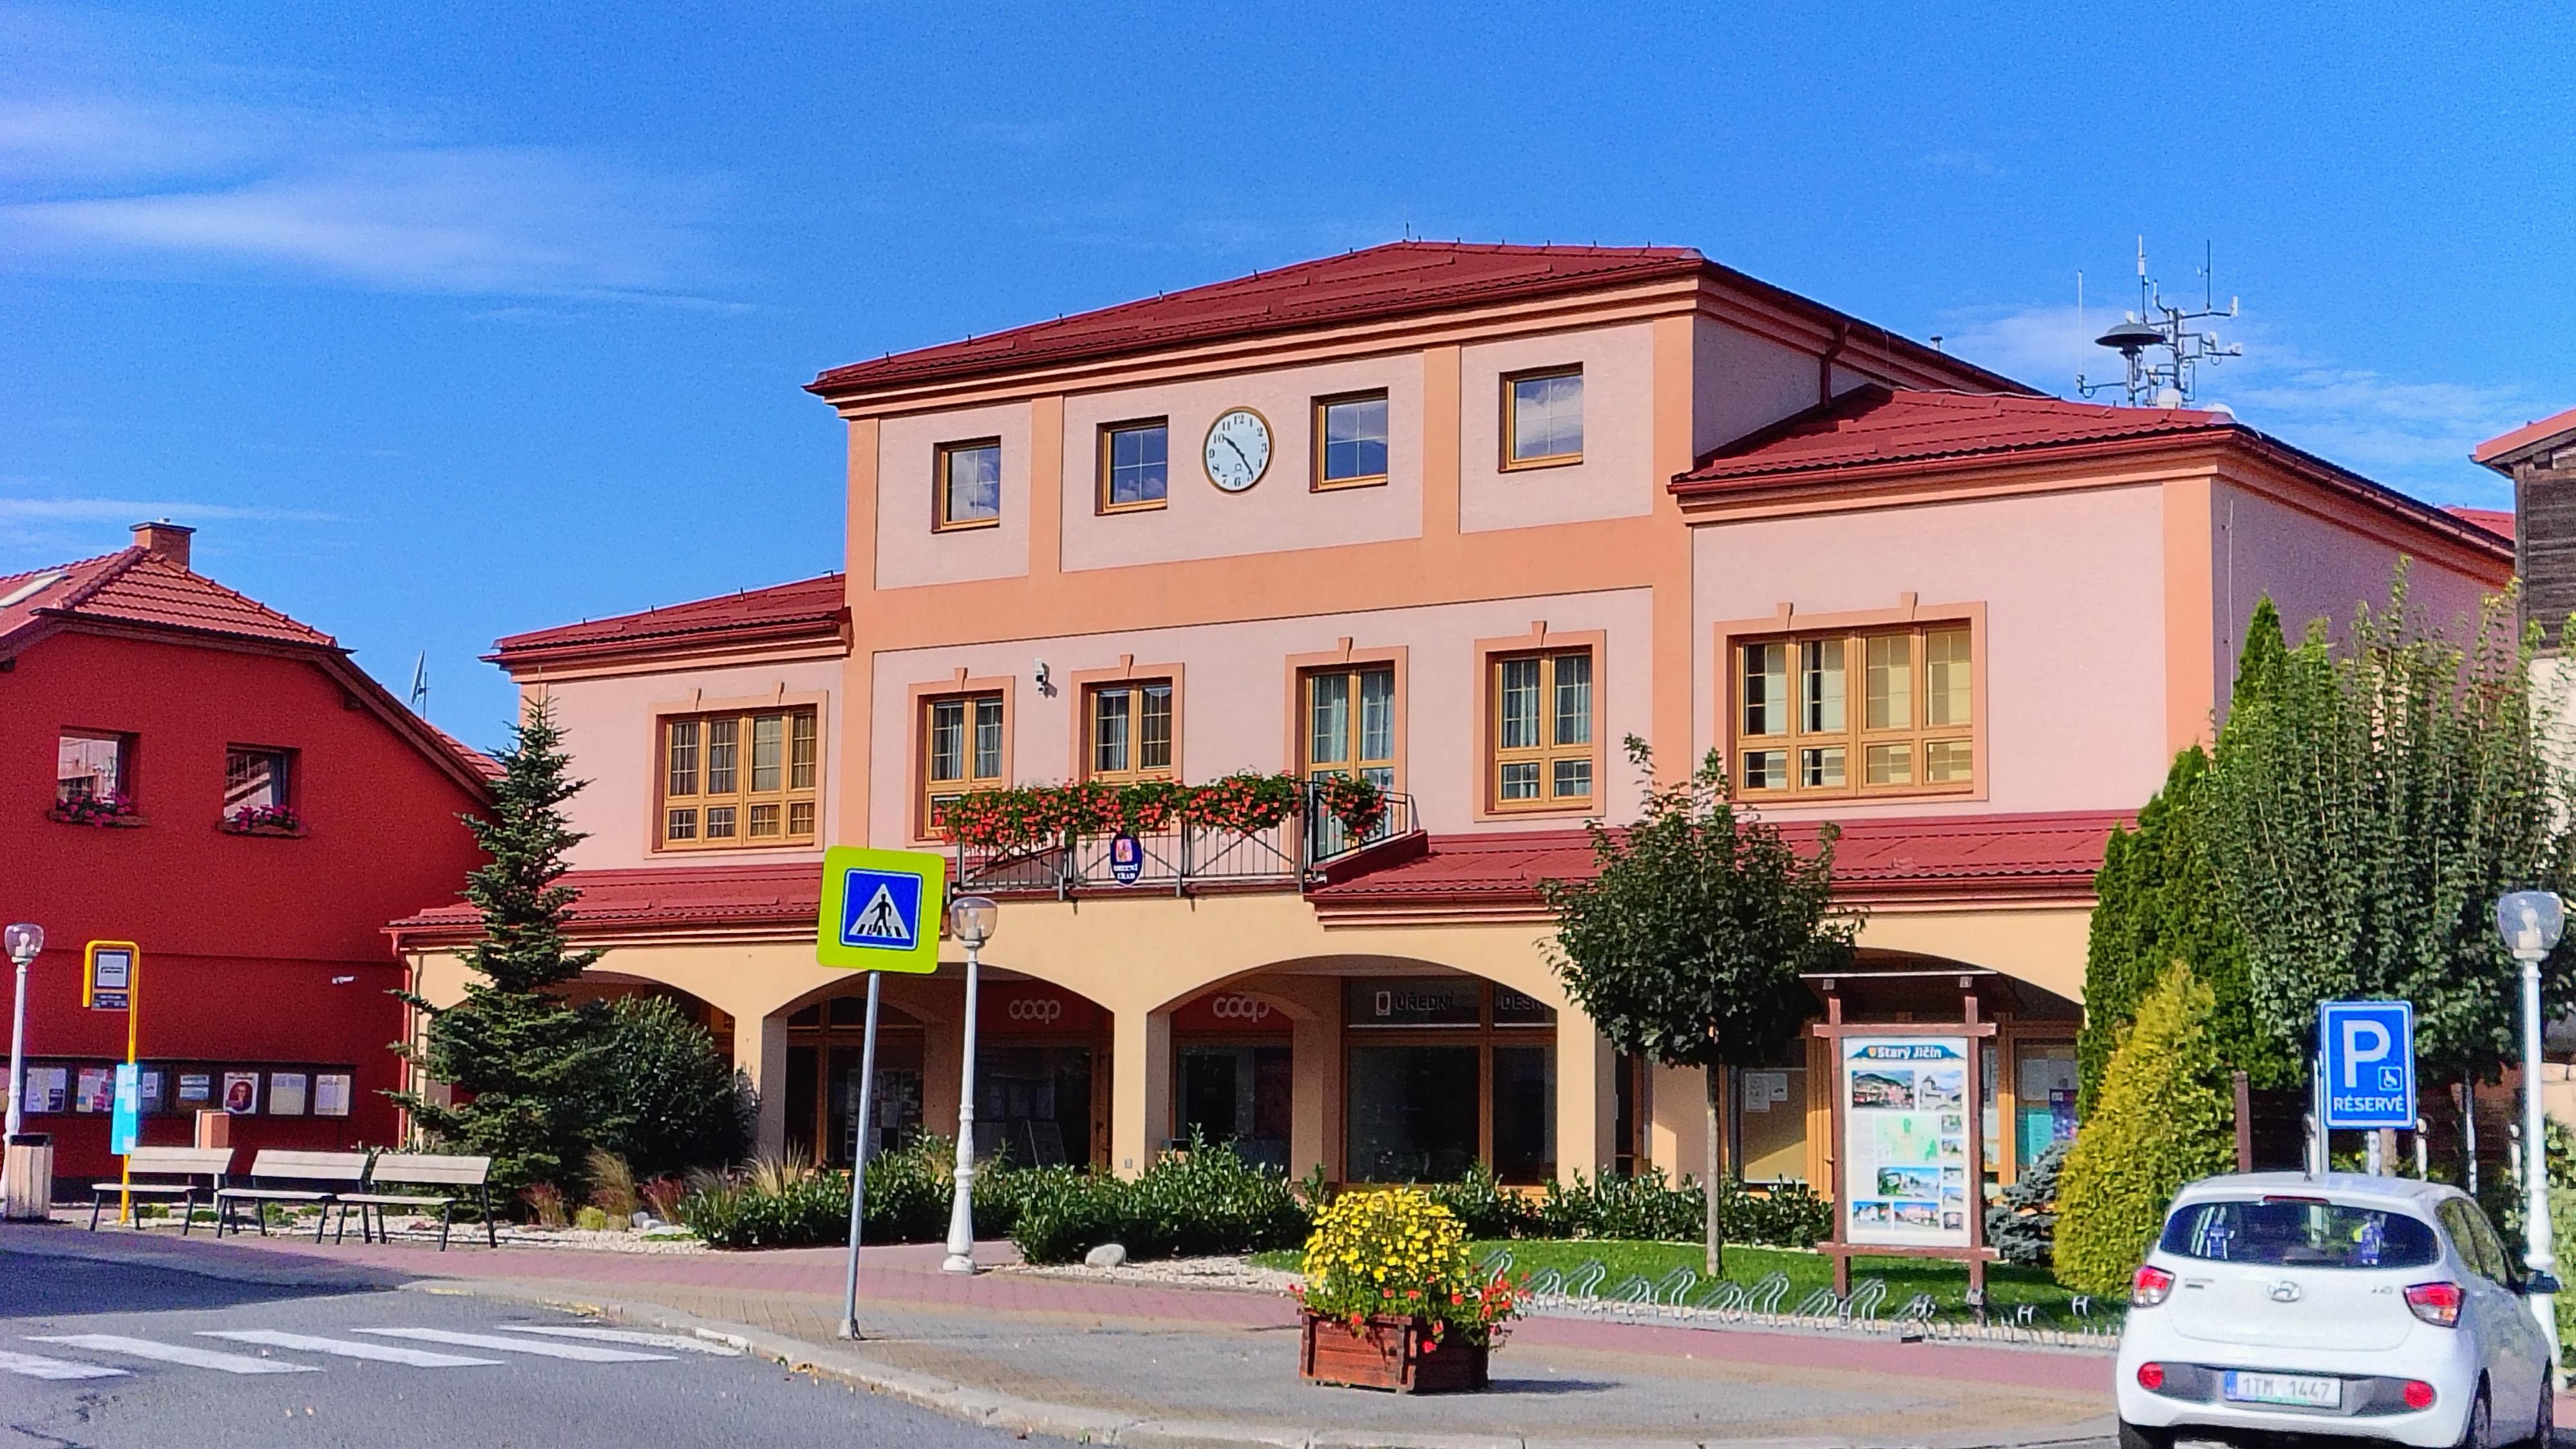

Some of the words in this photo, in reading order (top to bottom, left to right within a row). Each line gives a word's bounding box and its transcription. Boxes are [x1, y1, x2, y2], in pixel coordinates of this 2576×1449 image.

[1234, 414, 1244, 425] 12
[1222, 421, 1231, 431] 11
[1256, 426, 1264, 437] 2
[1213, 433, 1225, 444] 10
[1260, 442, 1267, 453] 3
[1208, 448, 1215, 459] 9
[1212, 463, 1220, 475] 8
[1222, 473, 1228, 484] 7
[1234, 477, 1241, 487] 6
[1009, 999, 1061, 1025] coop
[1213, 997, 1270, 1023] coop
[1877, 1046, 1911, 1060] Starý
[1913, 1046, 1942, 1059] Jičín
[2342, 1019, 2391, 1088] P
[2333, 1094, 2405, 1112] RÉSERVÉ
[2242, 1378, 2274, 1395] 1TM
[2287, 1380, 2331, 1401] 1447
